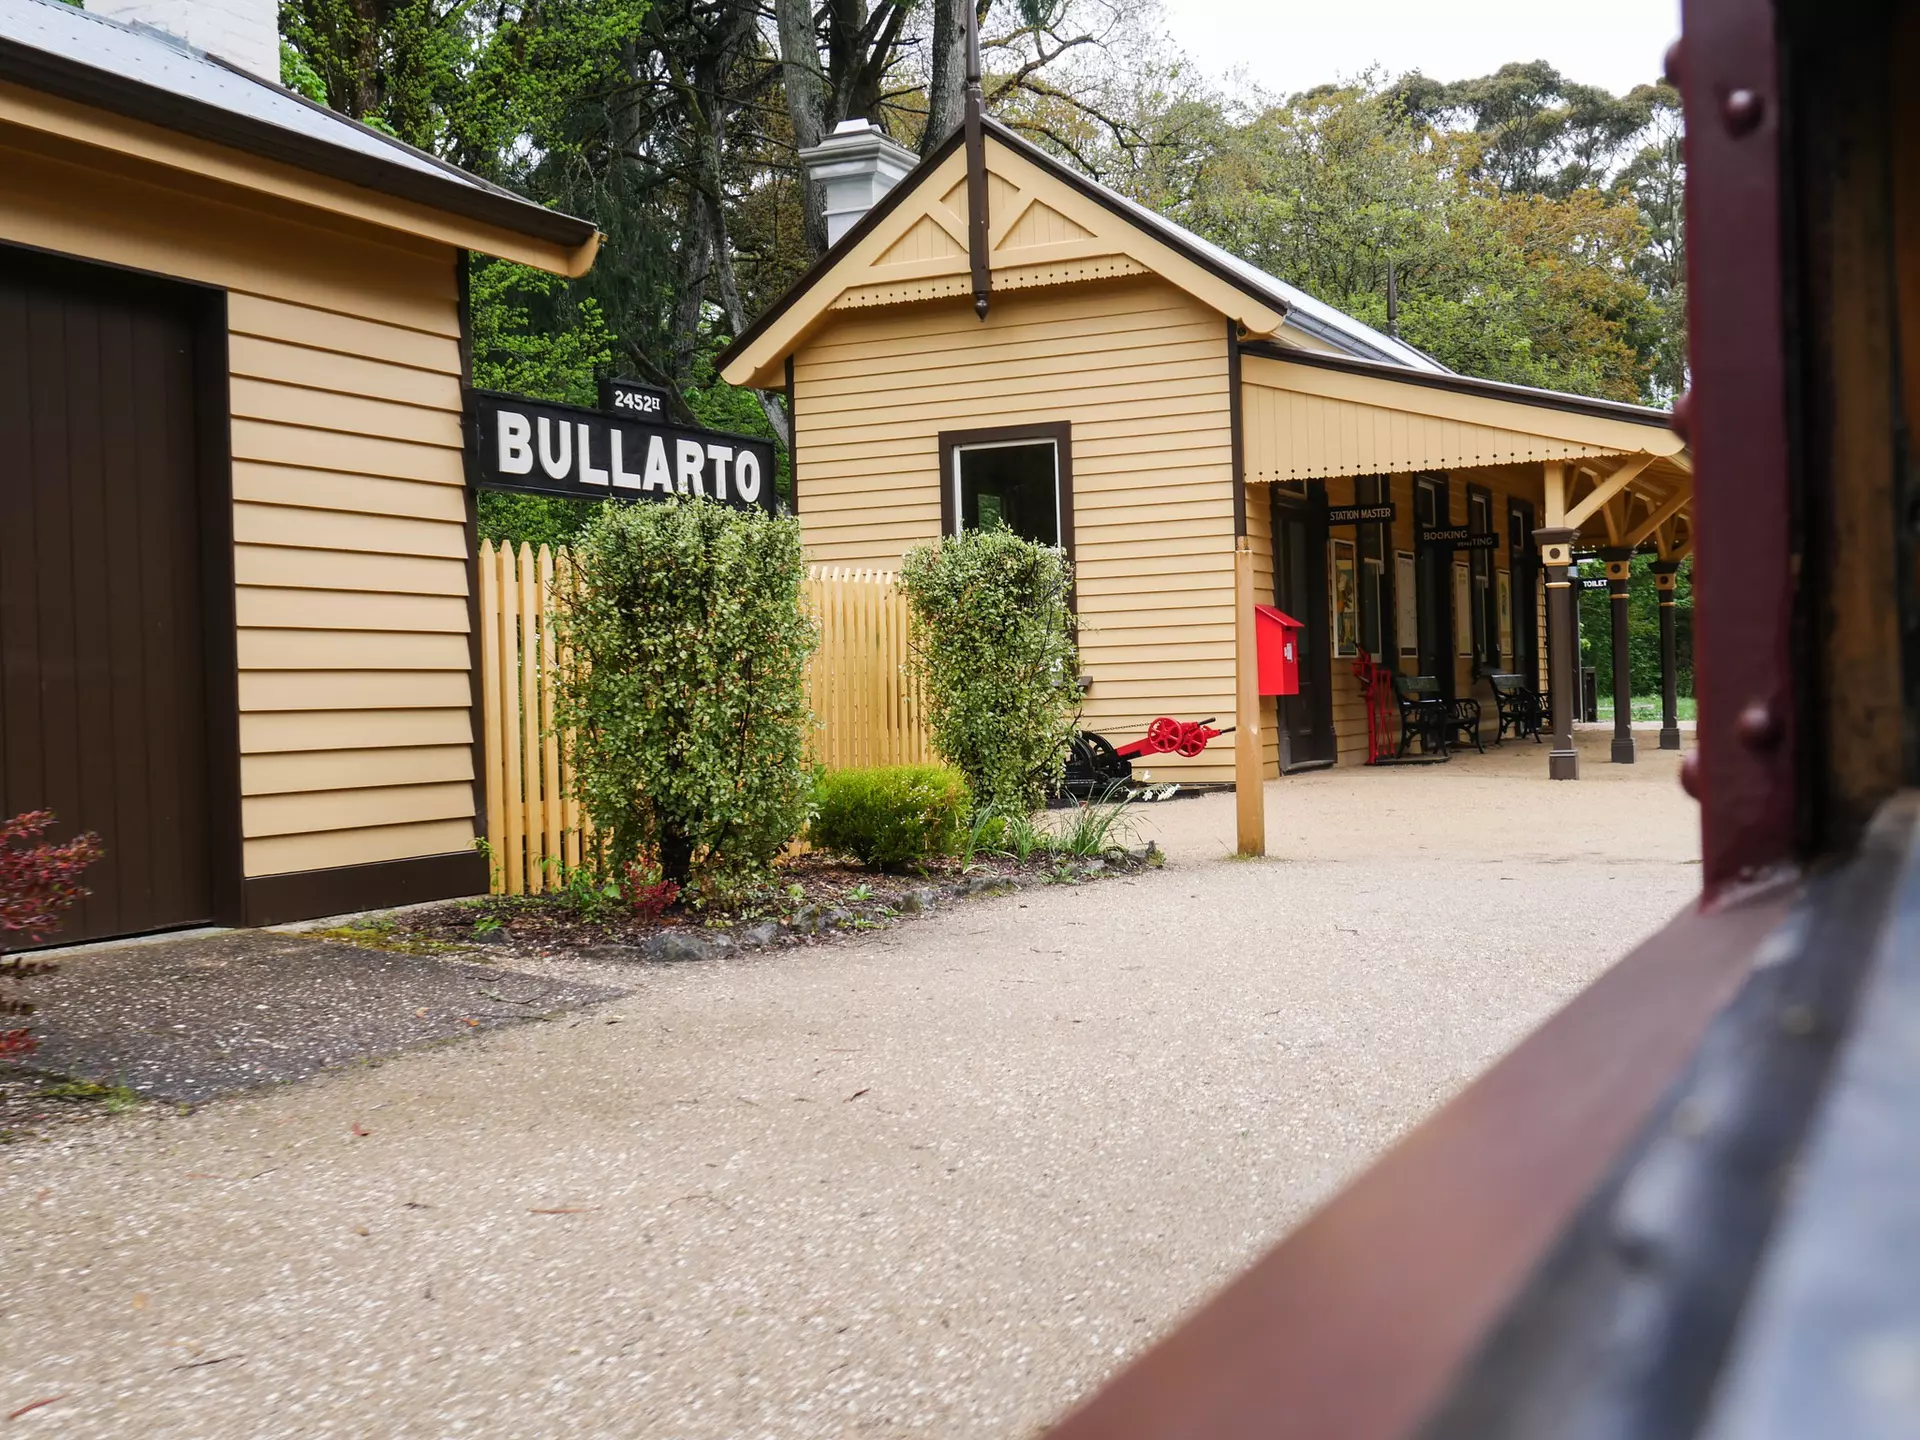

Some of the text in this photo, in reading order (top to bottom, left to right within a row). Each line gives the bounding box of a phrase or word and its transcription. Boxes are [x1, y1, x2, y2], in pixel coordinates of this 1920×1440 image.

[496, 410, 761, 502] BULLARTO
[1330, 507, 1391, 521] STATION MASTER
[1423, 529, 1468, 541] BOOKING
[1582, 579, 1608, 588] TOILET
